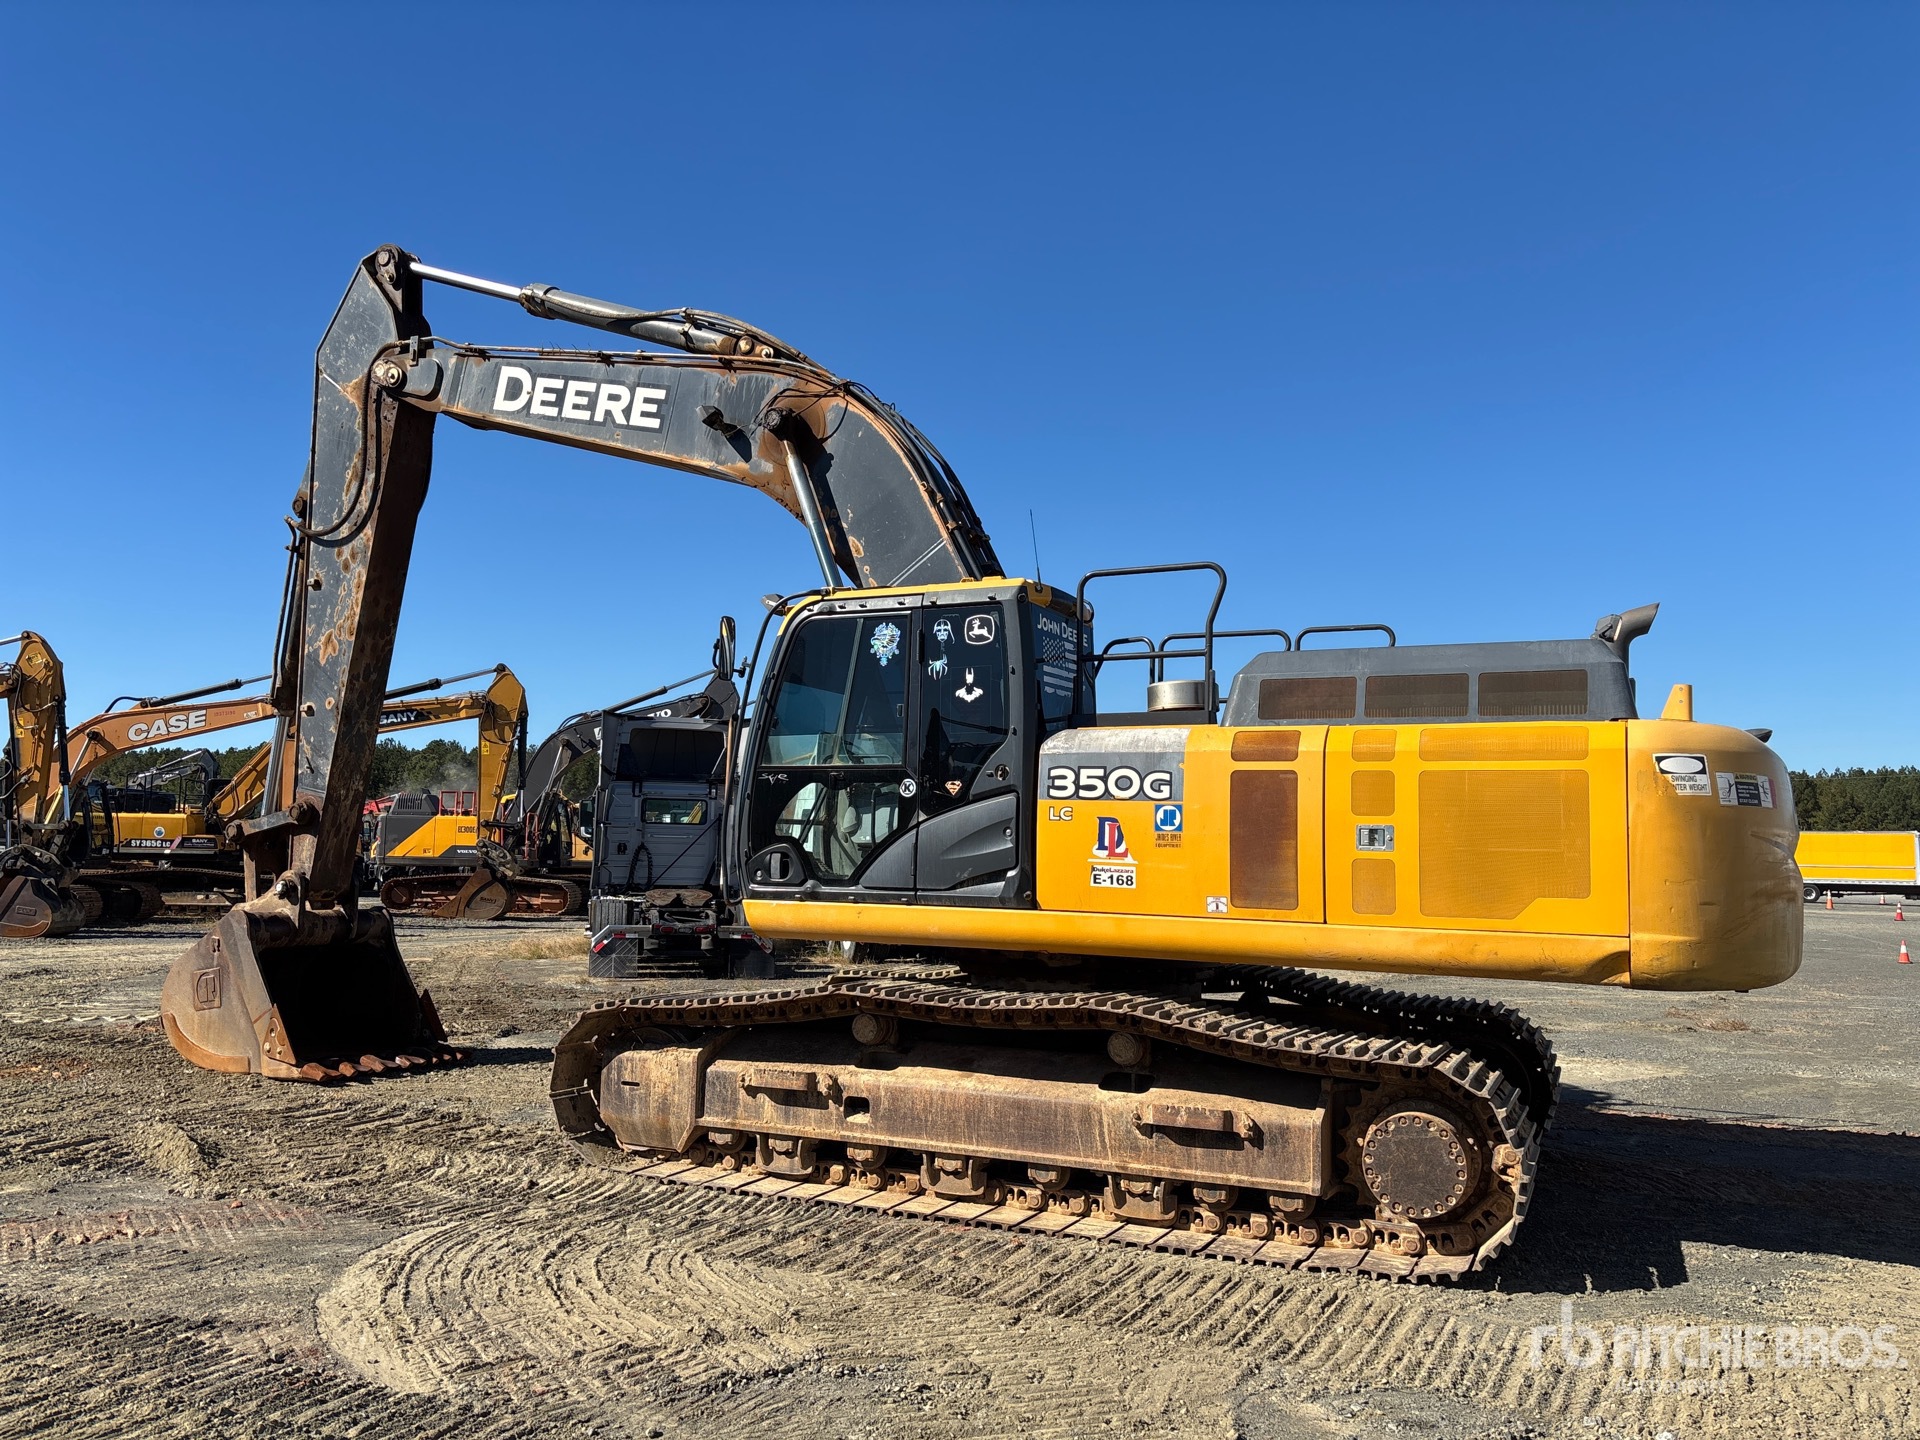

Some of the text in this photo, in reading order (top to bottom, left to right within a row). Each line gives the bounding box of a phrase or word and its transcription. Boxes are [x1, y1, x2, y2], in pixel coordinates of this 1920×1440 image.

[493, 365, 667, 429] DEERE
[1037, 613, 1089, 648] JOHN DEEE
[127, 709, 207, 742] CASE
[1047, 765, 1173, 801] 350G
[1671, 775, 1698, 783] SWINGING
[1688, 784, 1708, 792] WEIGHT
[1048, 806, 1073, 822] LC
[1155, 833, 1169, 842] JAMES
[1092, 873, 1135, 887] E-168
